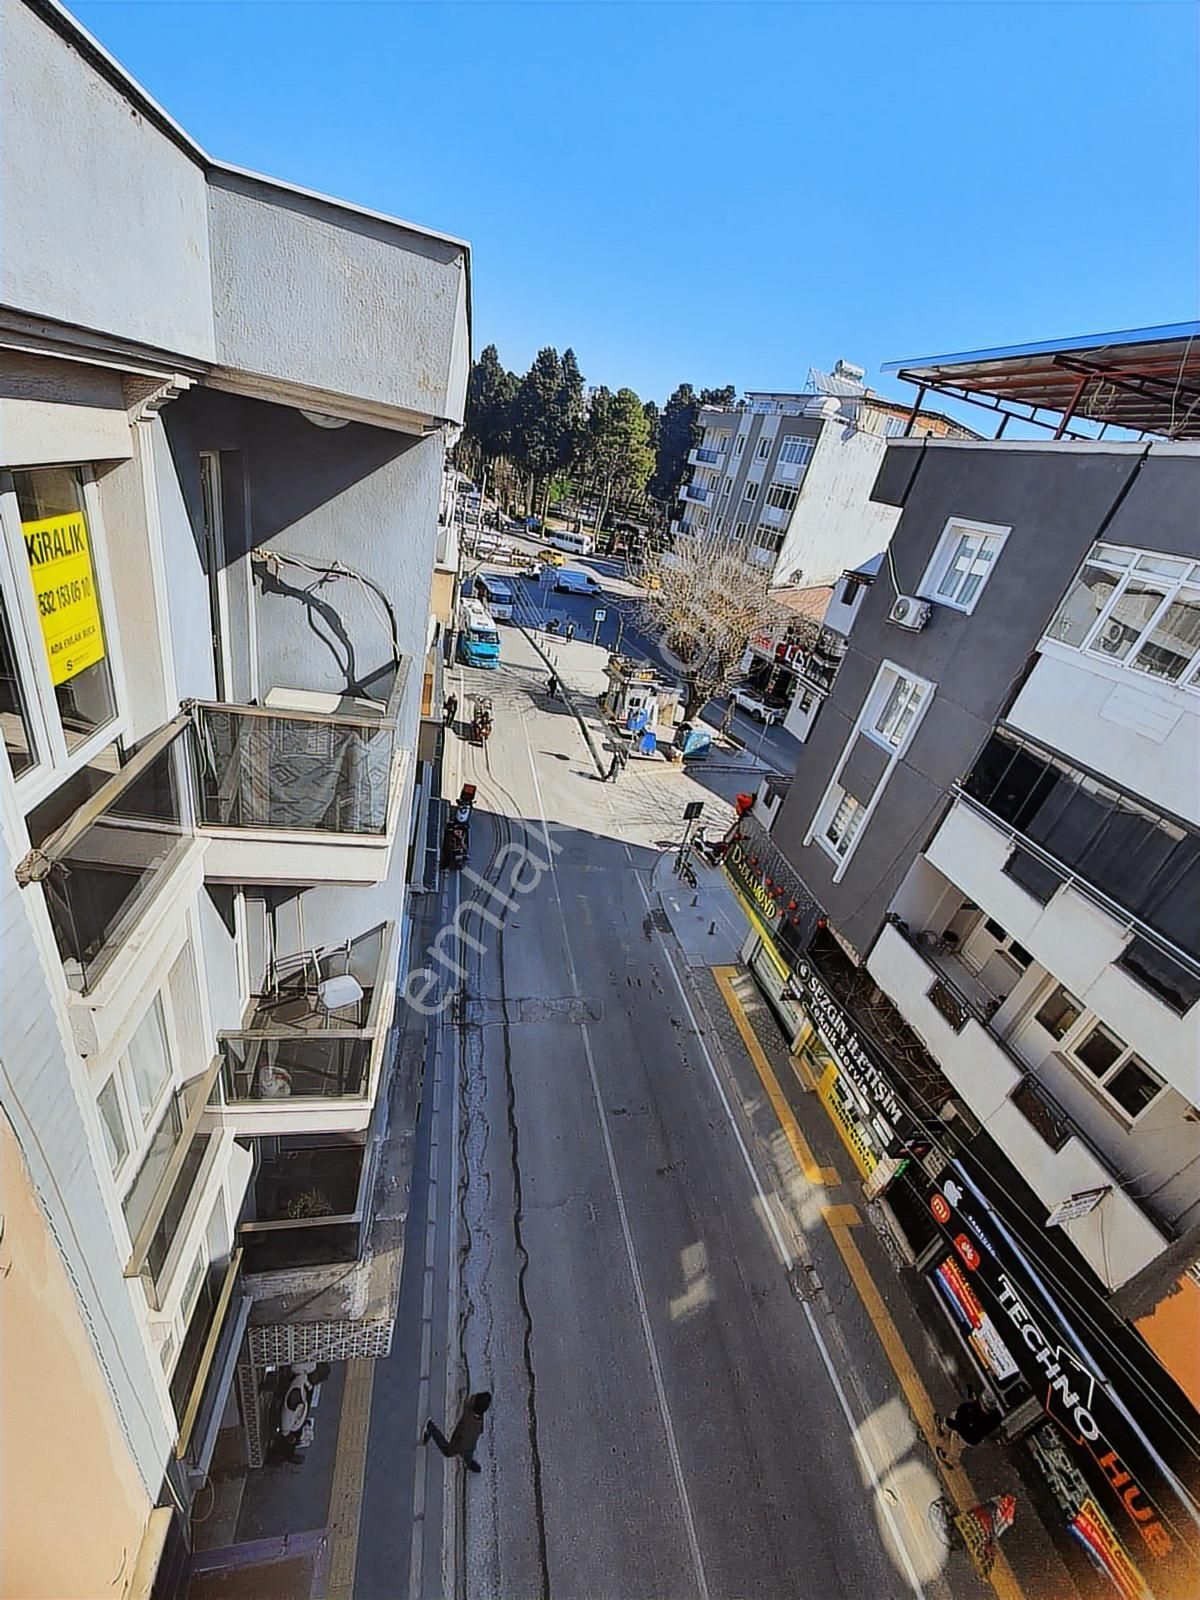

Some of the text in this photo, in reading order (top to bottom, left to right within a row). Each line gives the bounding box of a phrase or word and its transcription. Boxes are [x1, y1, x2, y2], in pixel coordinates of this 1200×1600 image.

[24, 523, 85, 567] KİRALIK
[37, 590, 57, 616] 532
[56, 584, 71, 609] 153
[809, 1001, 838, 1046] Teknik
[807, 974, 849, 1039] SEZGİN
[847, 1032, 903, 1125] İLETİŞİM
[998, 1277, 1100, 1441] TECHNO
